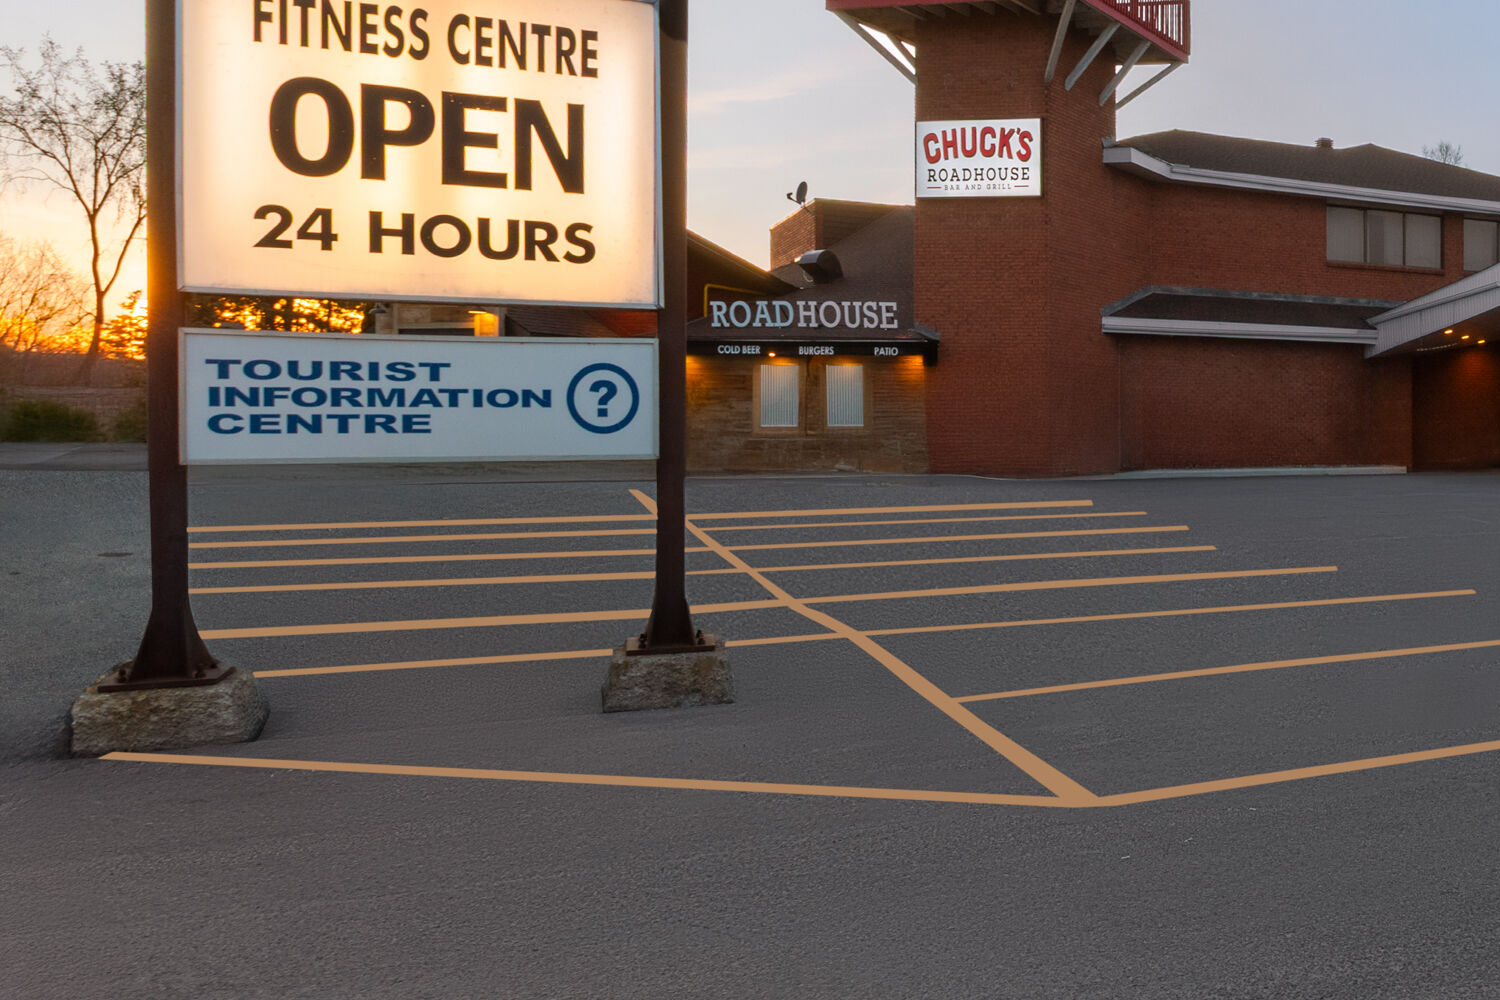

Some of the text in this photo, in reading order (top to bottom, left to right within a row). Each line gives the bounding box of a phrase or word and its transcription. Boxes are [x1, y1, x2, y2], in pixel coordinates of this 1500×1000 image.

[447, 13, 599, 79] CENTRE
[268, 76, 586, 195] OPEN
[923, 126, 1034, 165] CHUCK'S
[927, 167, 1030, 182] ROADHOUSE
[252, 203, 597, 265] 24 HOURS
[709, 300, 899, 329] ROADHOUSE
[717, 345, 761, 355] COLD BEER
[798, 346, 835, 356] BURGERS
[873, 347, 899, 356] PATIO
[204, 358, 451, 382] TOURIST
[207, 386, 552, 408] INFORMATION
[207, 413, 433, 434] CENTRE
